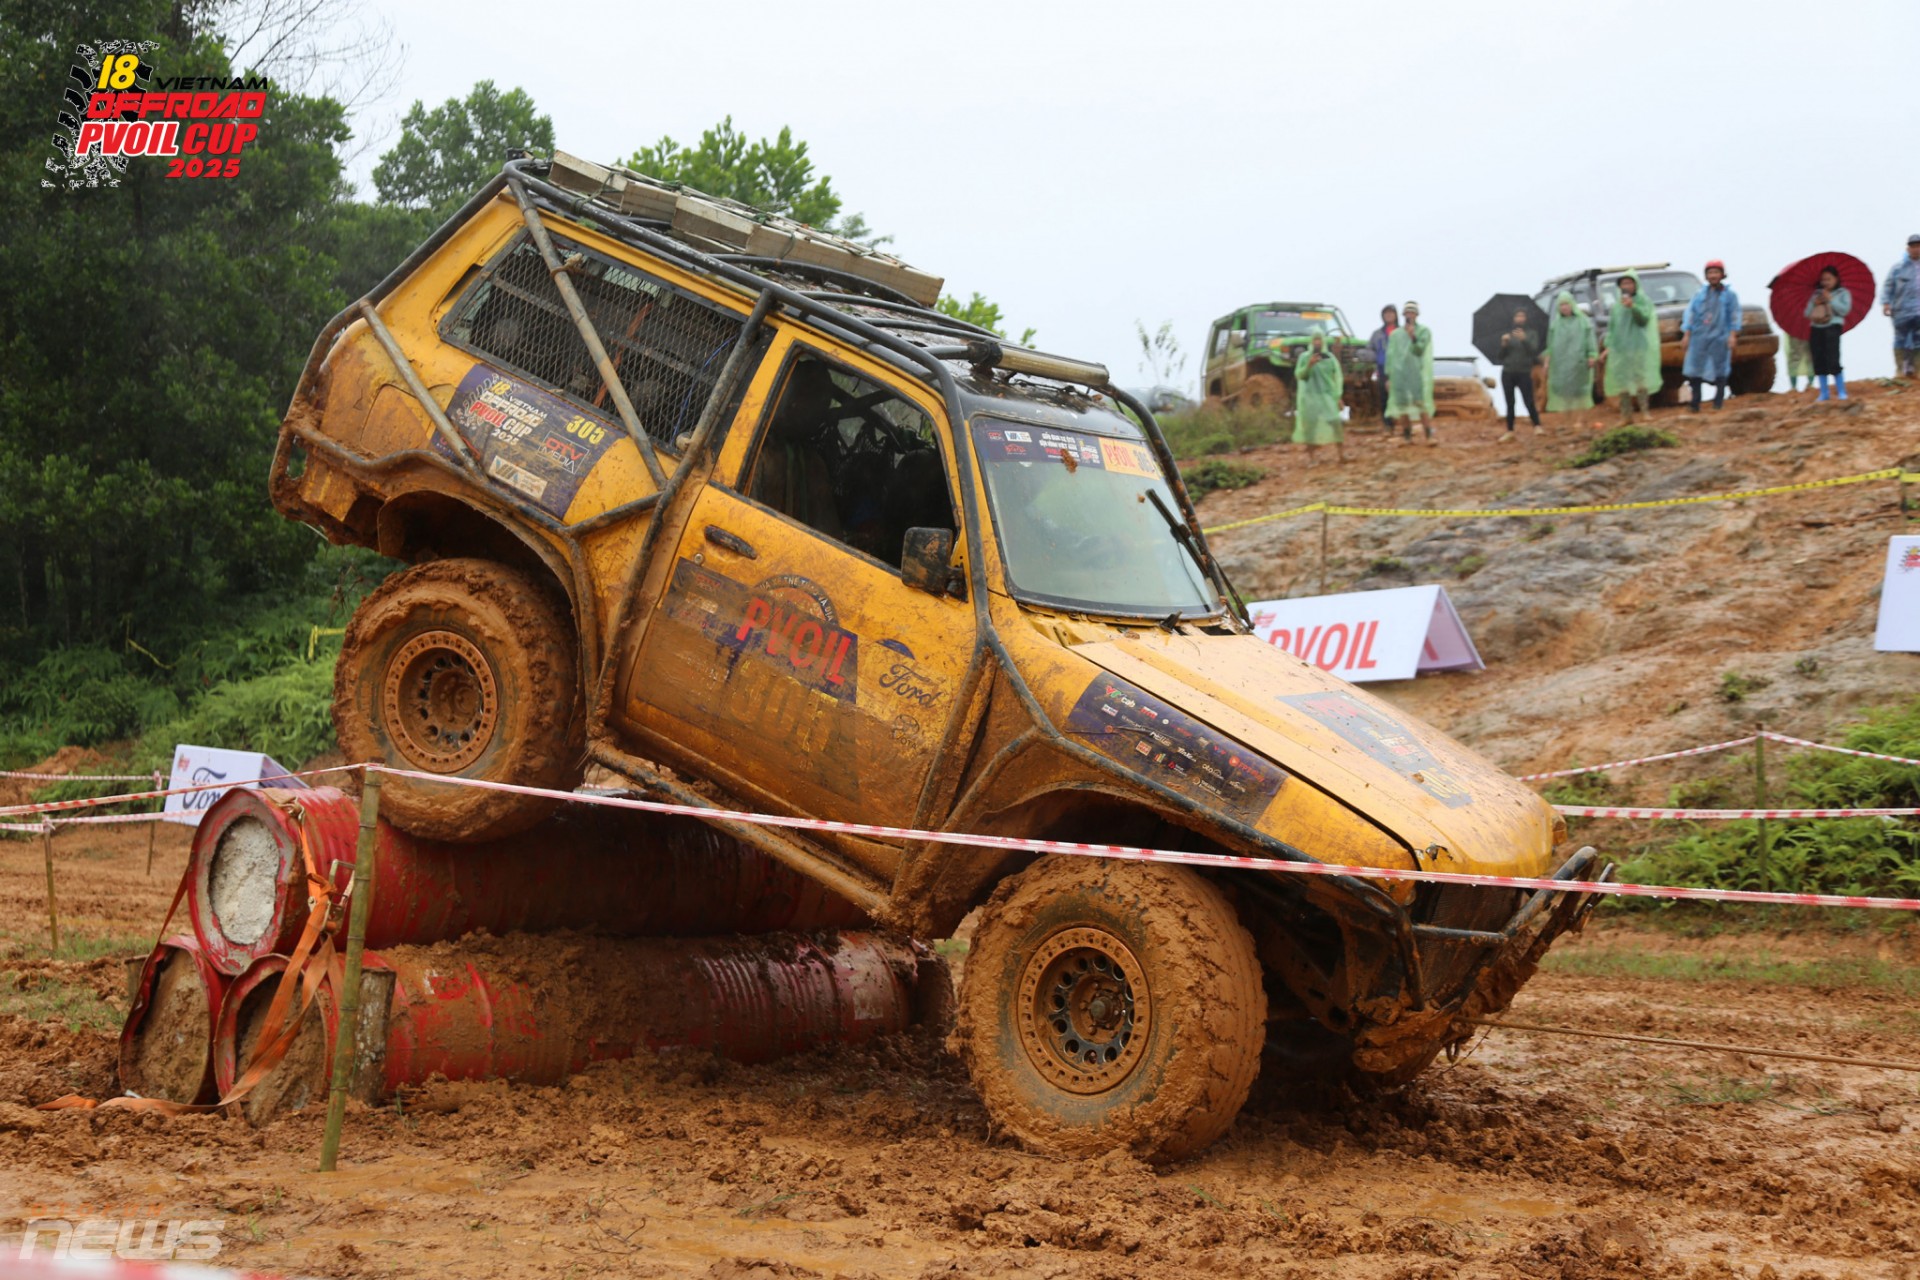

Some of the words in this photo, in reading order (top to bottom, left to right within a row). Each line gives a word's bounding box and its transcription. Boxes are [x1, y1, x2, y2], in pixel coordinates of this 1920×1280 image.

[490, 381, 511, 395] 18
[469, 400, 508, 428] PVOIL
[502, 418, 533, 437] CUP
[480, 391, 543, 428] OFFROAD
[509, 396, 547, 419] VIETNAM
[491, 428, 520, 445] 2025
[566, 415, 606, 446] 305
[735, 596, 852, 686] PVOIL
[1267, 620, 1379, 671] PVOIL
[879, 664, 945, 708] Ford
